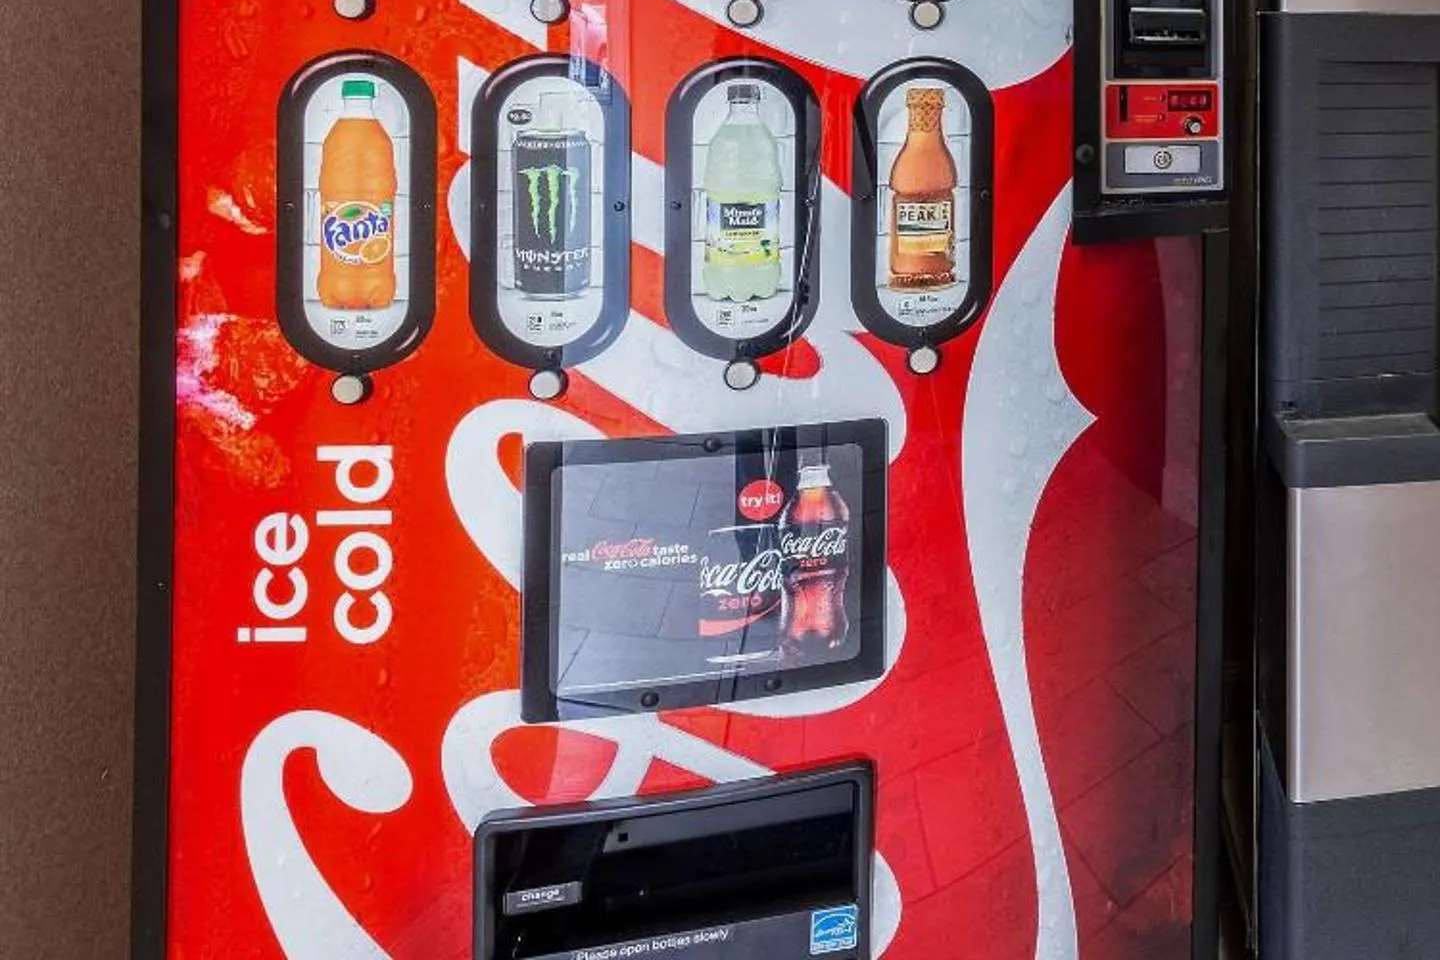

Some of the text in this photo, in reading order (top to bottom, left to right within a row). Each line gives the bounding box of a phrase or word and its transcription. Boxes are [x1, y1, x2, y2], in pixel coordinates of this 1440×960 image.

[899, 209, 936, 222] PEAK
[515, 246, 590, 265] MONSTER
[740, 492, 782, 508] try it!
[316, 444, 395, 645] cold
[561, 548, 590, 562] real
[653, 543, 689, 556] taste
[781, 527, 849, 560] Coca-Cola
[639, 553, 698, 568] calories
[800, 556, 828, 568] zero
[235, 511, 310, 643] ice
[718, 594, 763, 611] zero
[521, 888, 560, 902] change
[619, 943, 650, 957] open
[652, 934, 691, 950] bottles
